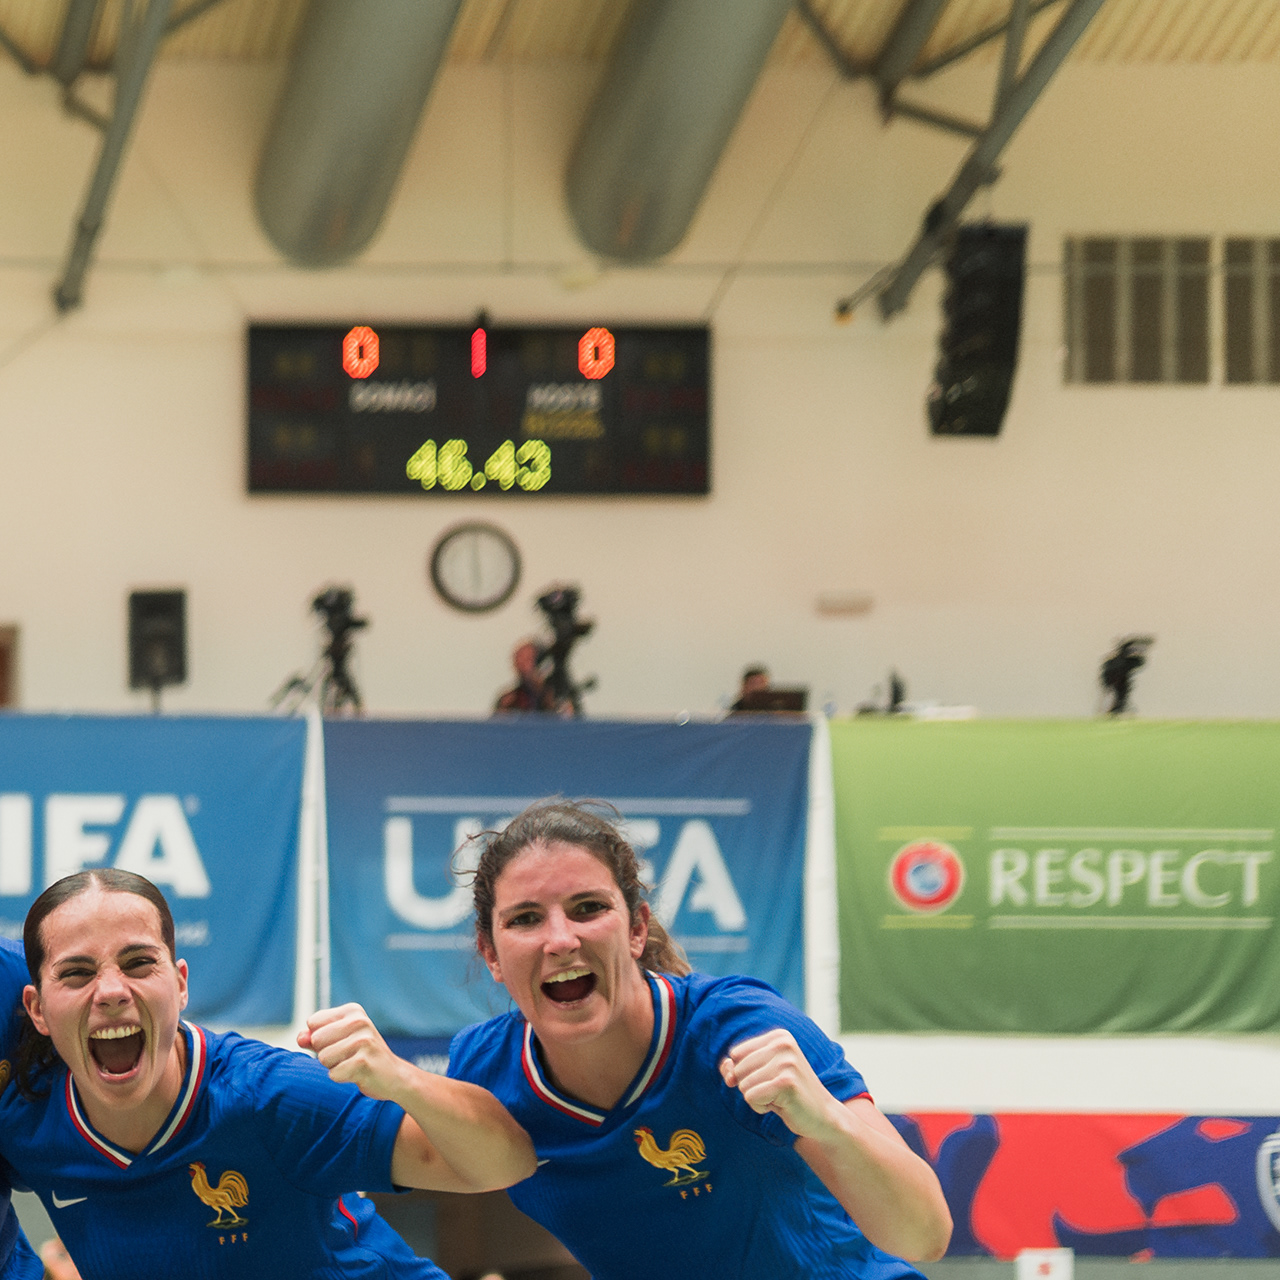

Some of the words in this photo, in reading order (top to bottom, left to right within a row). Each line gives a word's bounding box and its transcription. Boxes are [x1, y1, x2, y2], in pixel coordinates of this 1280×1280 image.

[343, 326, 380, 379] 0
[578, 327, 616, 379] 0
[989, 848, 1272, 908] RESPECT
[679, 1183, 713, 1200] FFF
[219, 1232, 248, 1246] FFF
